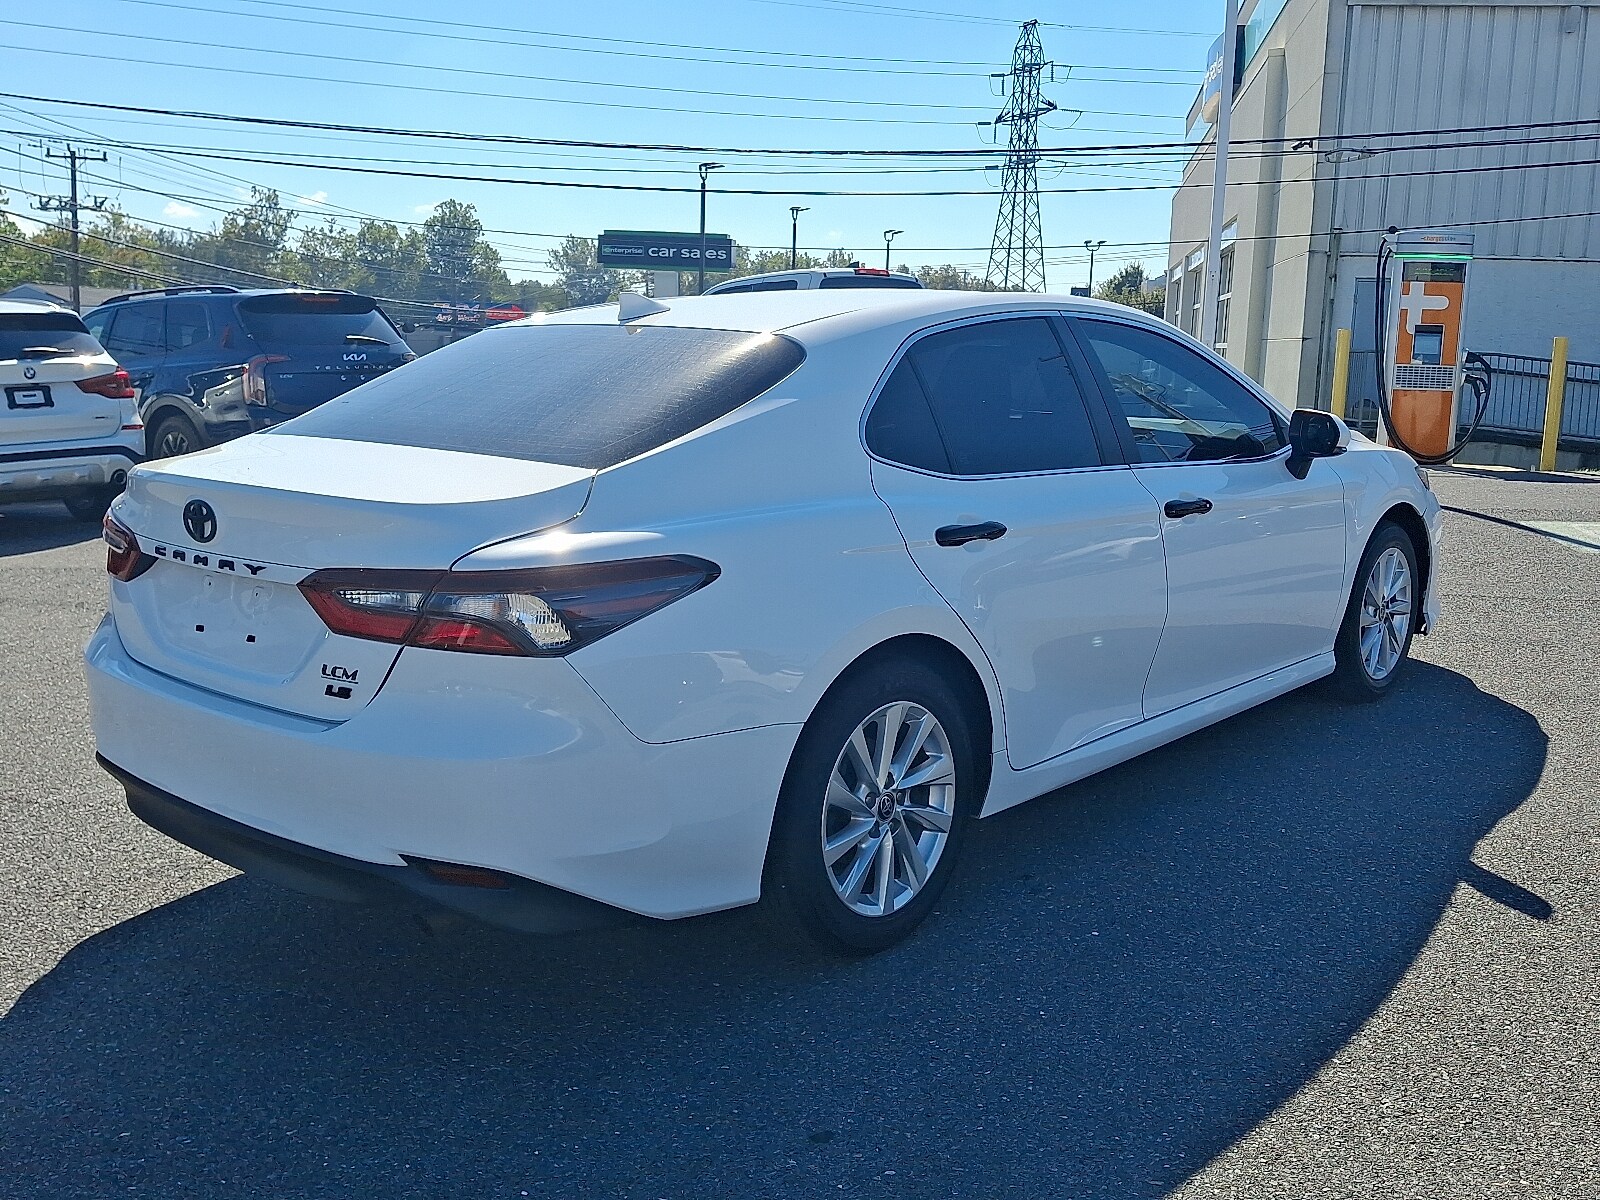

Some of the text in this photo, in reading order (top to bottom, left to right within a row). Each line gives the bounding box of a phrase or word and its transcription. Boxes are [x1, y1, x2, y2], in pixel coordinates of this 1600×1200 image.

[648, 247, 677, 258] car
[681, 247, 727, 260] saes
[342, 353, 367, 361] KIA
[154, 544, 268, 576] CAMRY
[321, 663, 359, 681] LCM
